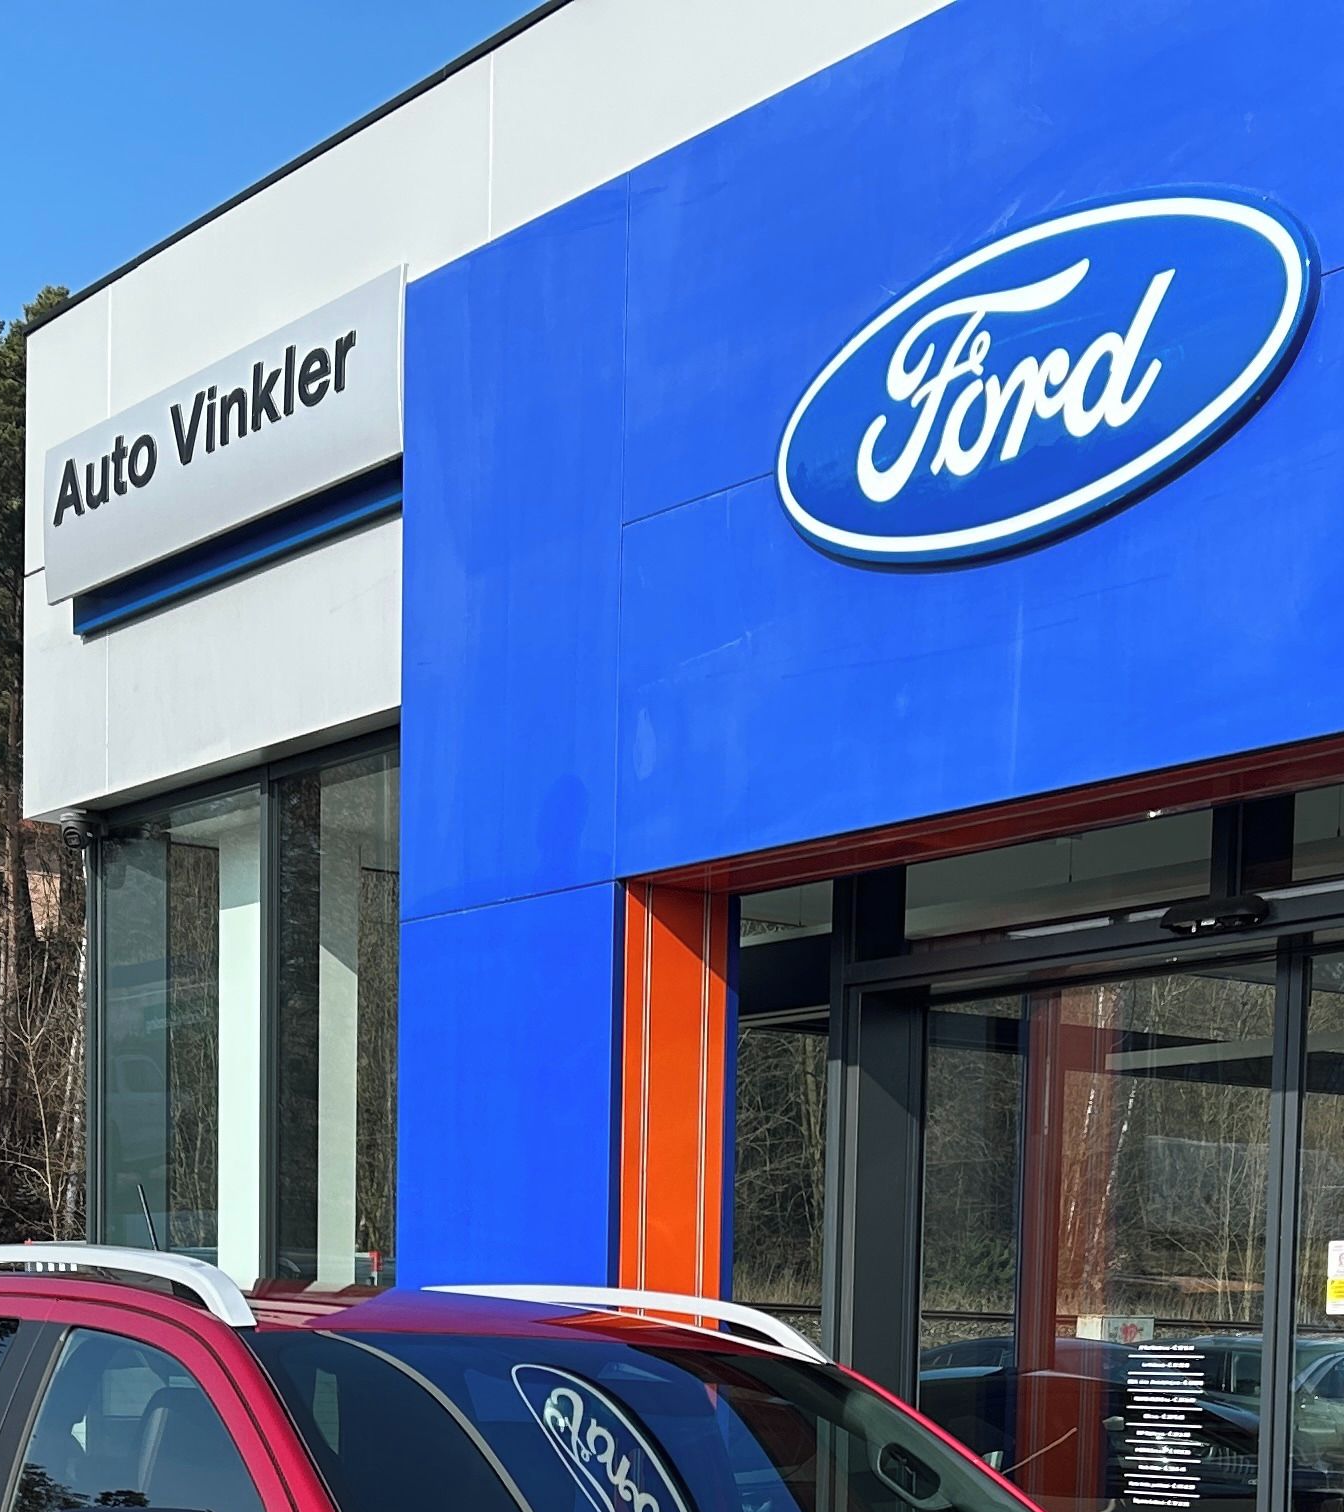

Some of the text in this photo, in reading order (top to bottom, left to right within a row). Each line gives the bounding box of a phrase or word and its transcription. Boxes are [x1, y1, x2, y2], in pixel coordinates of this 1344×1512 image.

[53, 329, 357, 528] Auto Vinkler
[856, 257, 1176, 503] Ford
